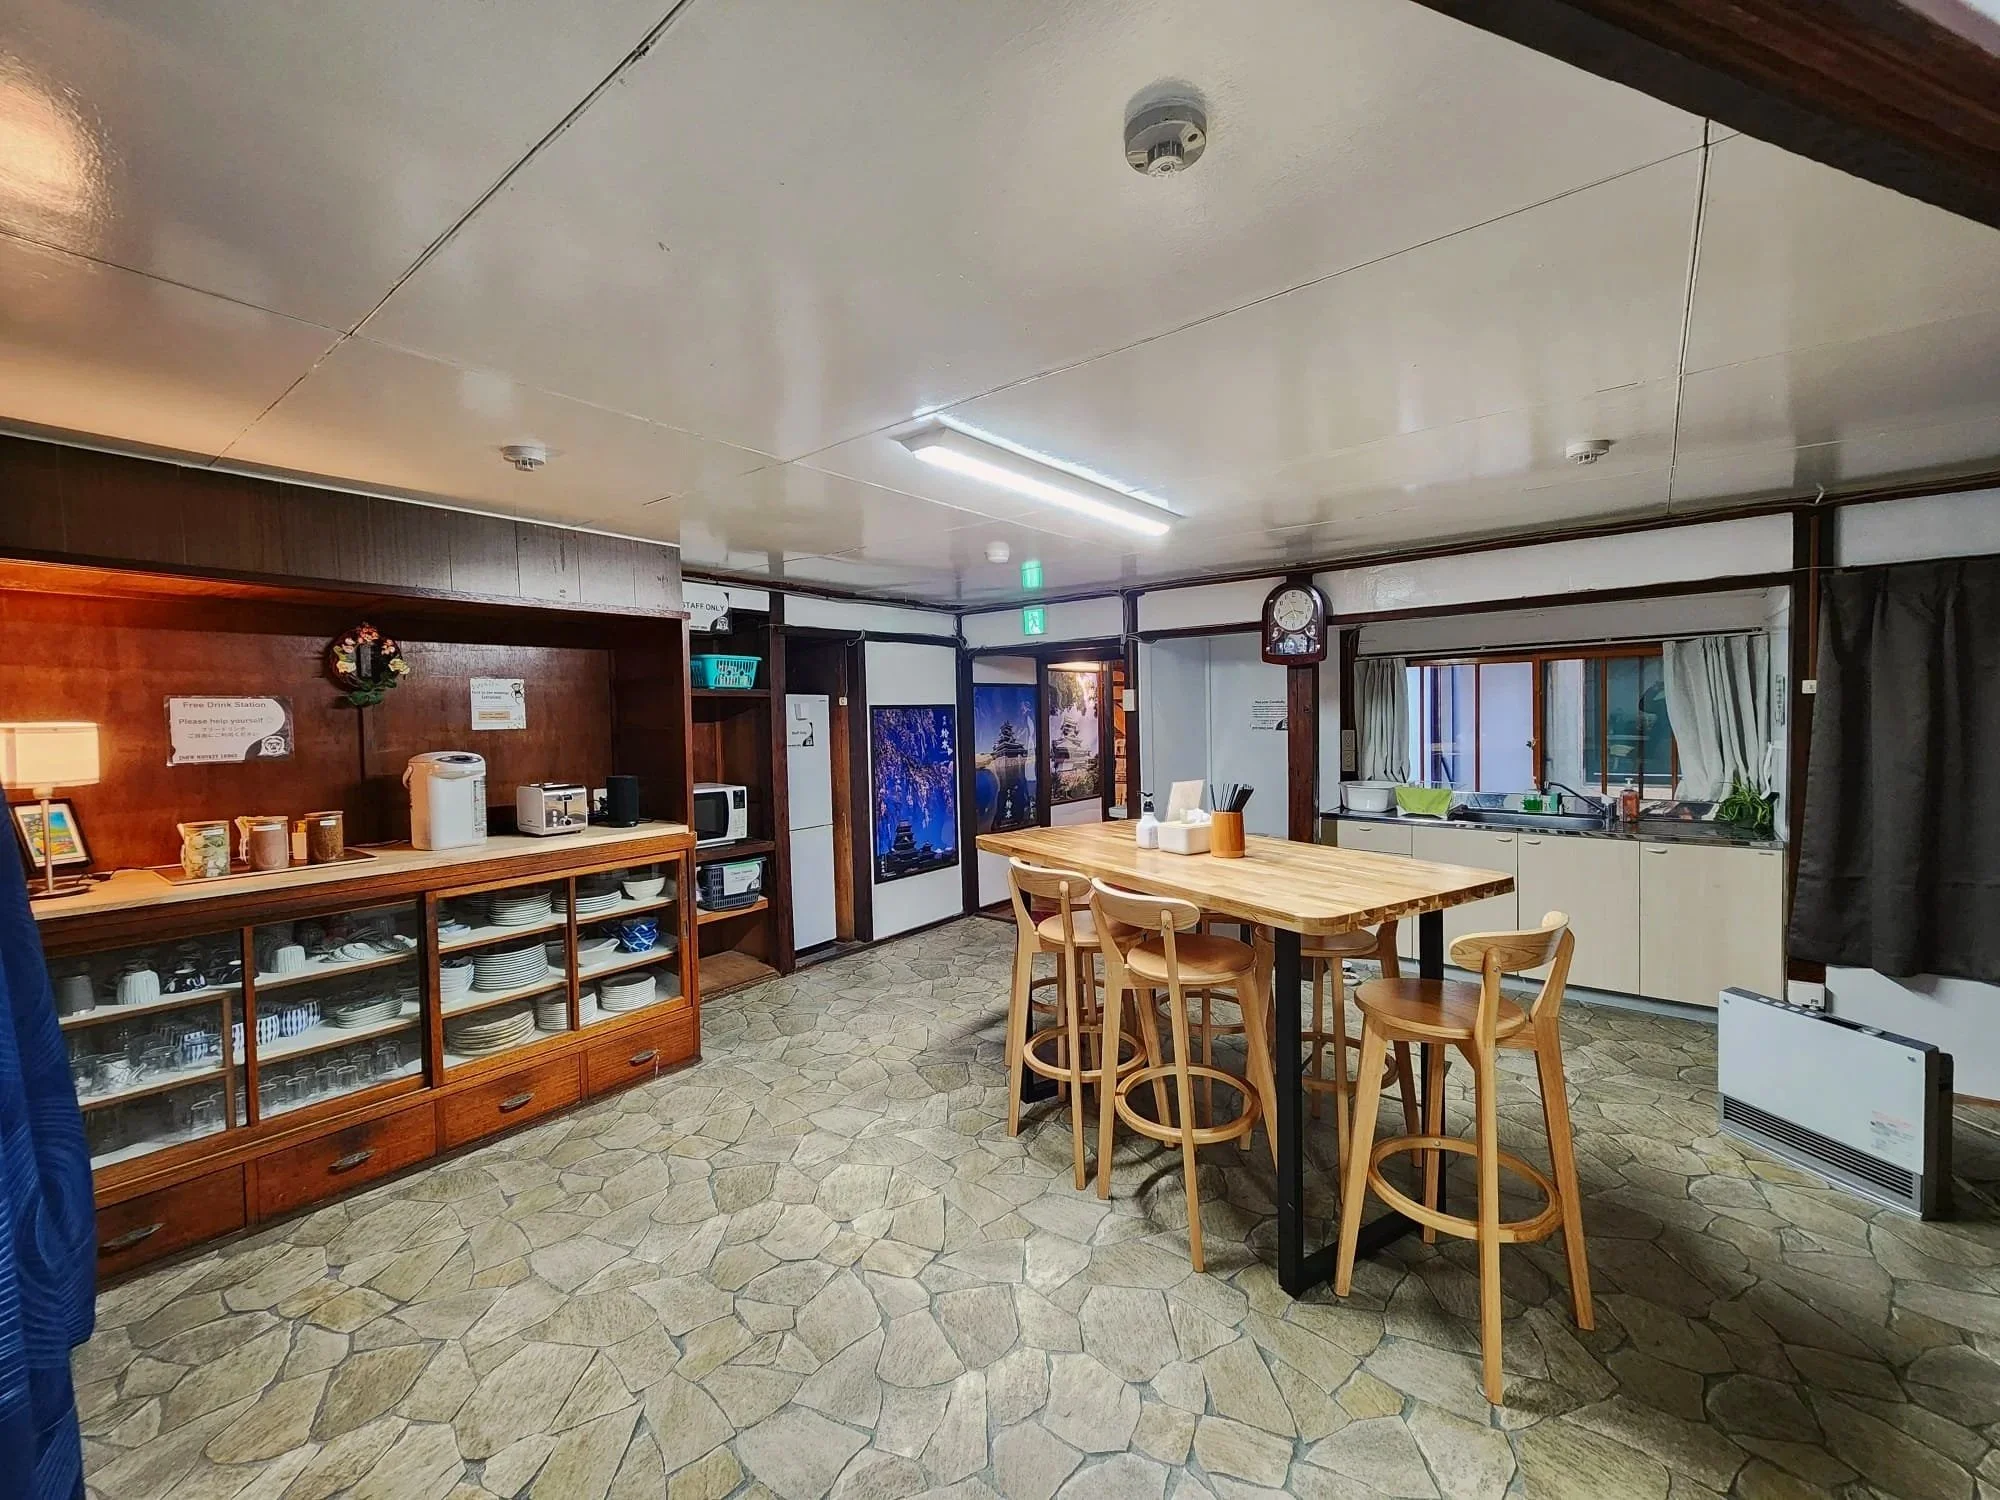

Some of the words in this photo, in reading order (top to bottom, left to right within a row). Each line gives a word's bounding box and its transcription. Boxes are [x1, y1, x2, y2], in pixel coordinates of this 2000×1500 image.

[705, 603, 725, 611] ONLY
[210, 717, 229, 725] help
[230, 716, 263, 725] yourself
